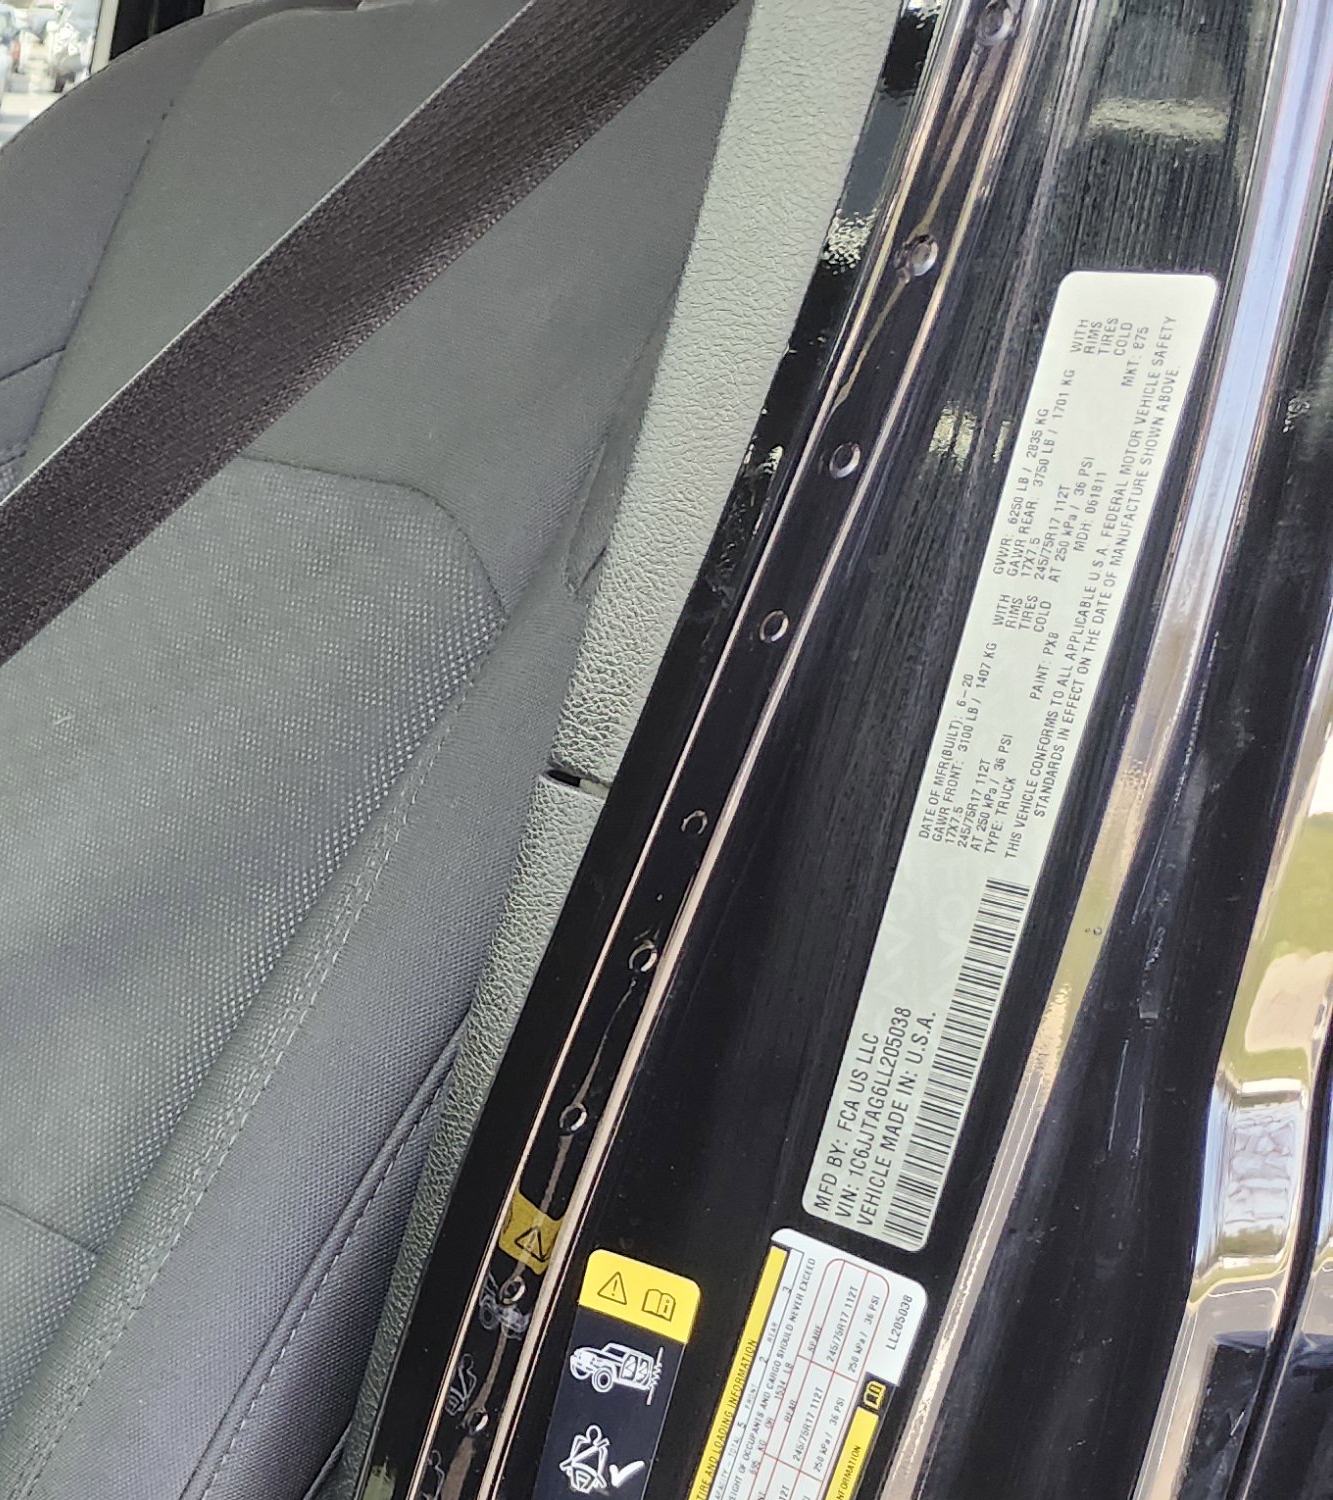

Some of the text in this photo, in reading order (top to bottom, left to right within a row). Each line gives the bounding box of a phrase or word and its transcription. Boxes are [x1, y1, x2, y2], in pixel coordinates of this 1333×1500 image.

[1069, 319, 1089, 353] WITH
[1082, 321, 1103, 355] RIMS
[1097, 317, 1119, 355] TIRES
[1112, 322, 1134, 357] COLD
[1033, 484, 1071, 581] 245/75R17 112T
[1047, 456, 1095, 583] AT 250 kPa 36 PSI
[1020, 537, 1041, 577] 17X7.5
[1004, 316, 1177, 858] THIS VEHICLE CONFORMS TO ALL APPLICABLE U.S.A. FEDERAL MOTOR VEHICLE SAFETY
[1033, 370, 1180, 818] STANDARDS IN EFFECT ON THE DATE OF MANUFACTURE SHOWN ABOVE.
[992, 594, 1011, 626] WITH
[1004, 597, 1023, 629] RIMS
[1017, 594, 1039, 630] TIRES
[1032, 600, 1052, 633] COLD
[1029, 663, 1050, 701] PAINT:
[931, 642, 998, 842] GAWR FRONT: 3100 LB 1407 KG
[956, 758, 991, 849] 245/75R17 112T
[969, 733, 1013, 852] AT 250 kPa 36 PSI
[944, 806, 964, 844] 17X7.5
[983, 776, 1017, 854] TYPE: TRUCK
[813, 1032, 879, 1212] MFD BY: FCA US LLC
[834, 1006, 912, 1218] VIN: 1C6JJTAG6LL205038
[856, 1012, 937, 1226] VEHICLE MADE IN: U.S.A.
[798, 1257, 816, 1292] EXCEED
[788, 1293, 804, 1323] NEVER
[826, 1285, 859, 1363] 245/75R17 112T
[885, 1294, 913, 1351] LL205038
[776, 1323, 794, 1360] SHOULD
[766, 1359, 782, 1390] CARGO
[704, 1455, 721, 1481] AND
[713, 1410, 736, 1457] LOADING
[727, 1339, 760, 1411] INFORMATION
[759, 1391, 771, 1410] AND
[742, 1411, 765, 1462] OCCUPANTS
[792, 1386, 824, 1462] 245/75R17 112T
[738, 1463, 747, 1474] OF
